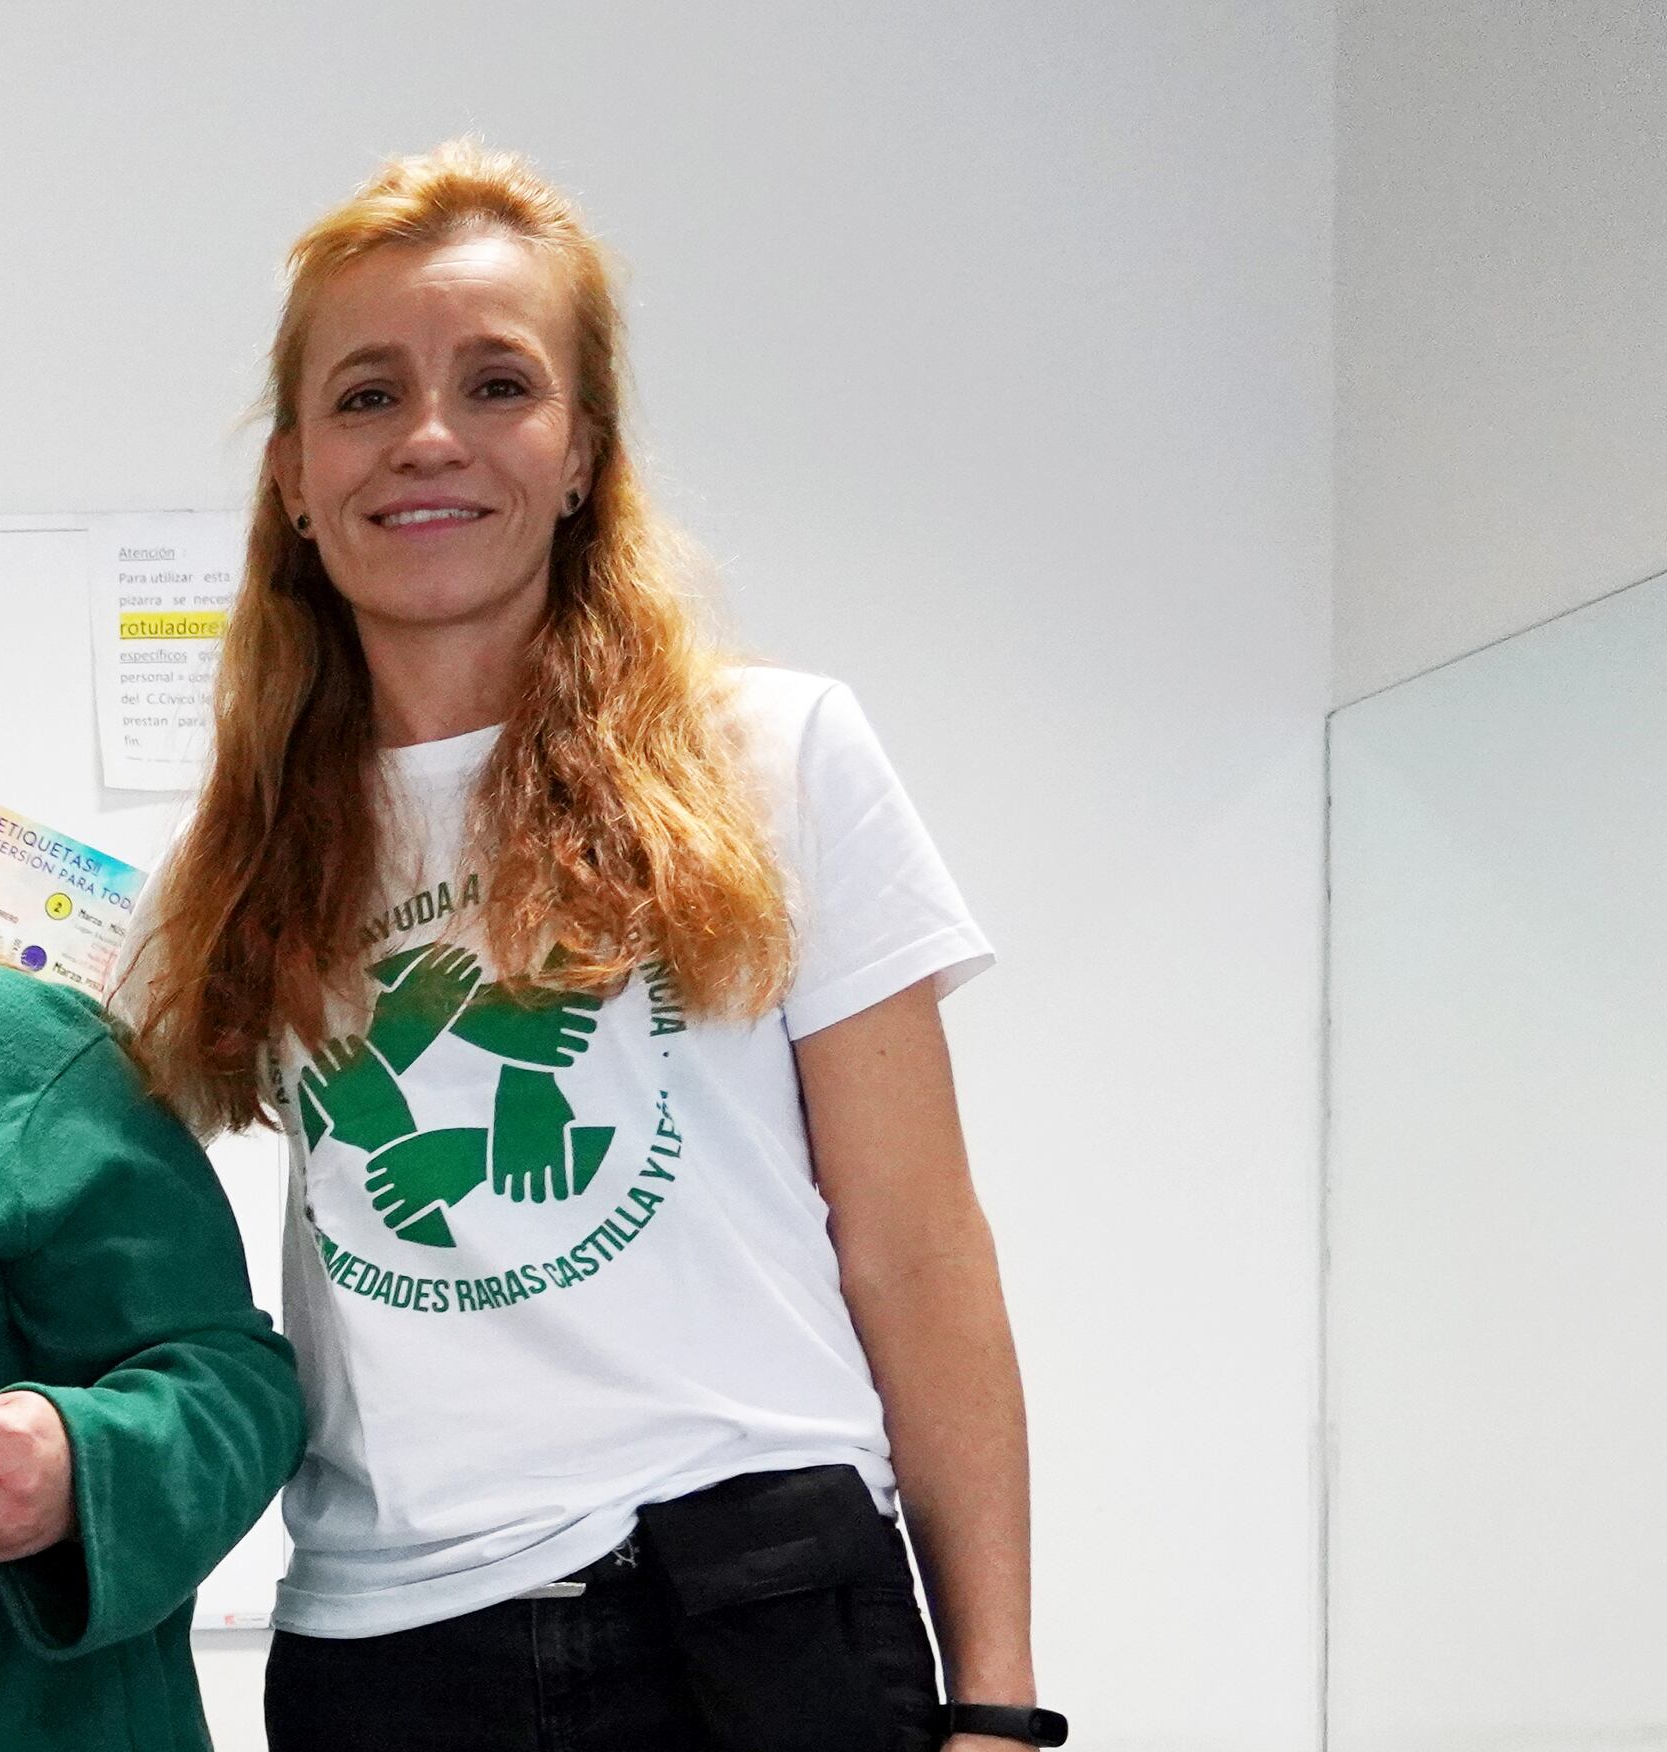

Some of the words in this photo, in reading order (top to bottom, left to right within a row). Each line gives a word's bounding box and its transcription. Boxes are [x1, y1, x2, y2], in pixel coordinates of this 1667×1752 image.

[57, 867, 95, 895] PARA
[456, 1263, 547, 1312] RARAS
[543, 1186, 665, 1289] CASTILLA
[639, 1156, 676, 1183] Y
